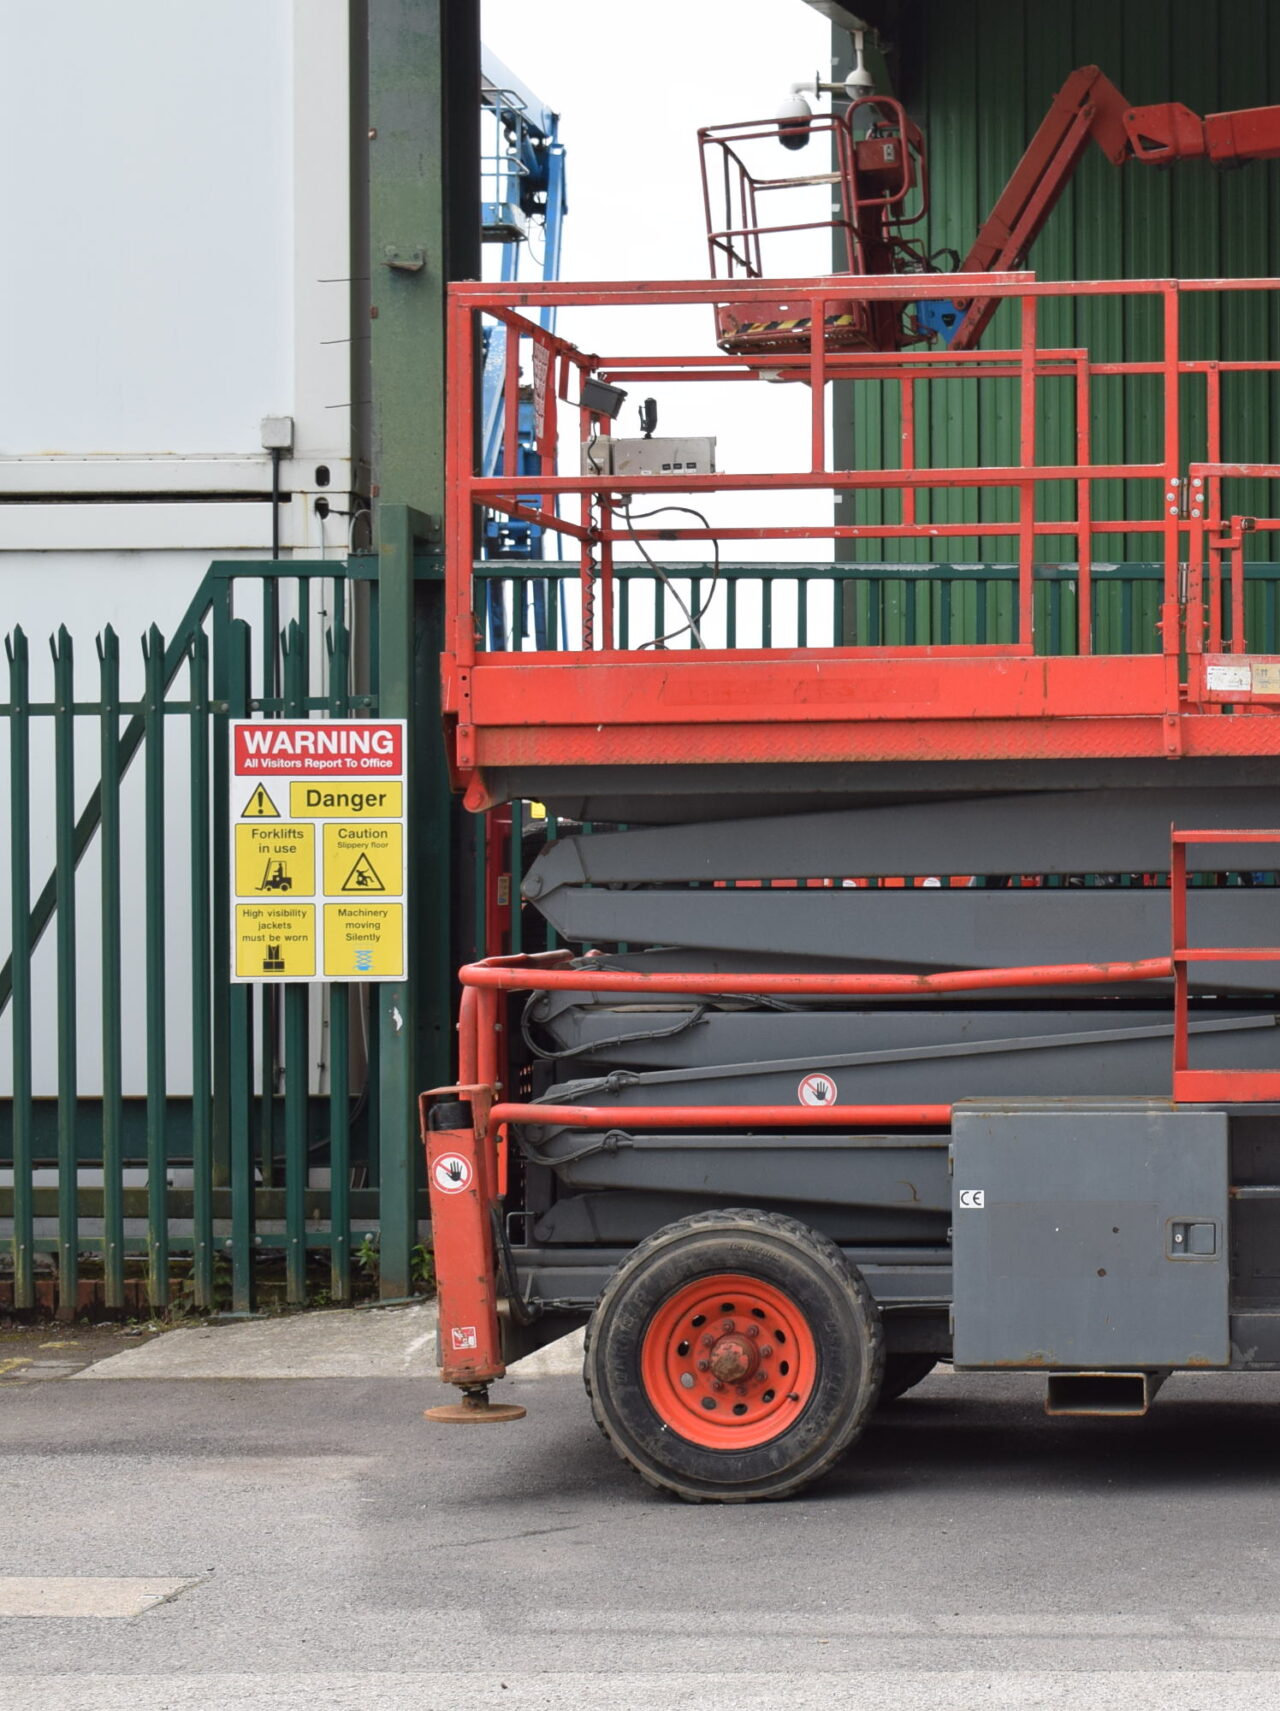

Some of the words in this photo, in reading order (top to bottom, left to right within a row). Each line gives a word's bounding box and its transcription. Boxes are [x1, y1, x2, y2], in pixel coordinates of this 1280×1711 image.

[244, 730, 394, 755] WARNING
[244, 758, 258, 768] All
[260, 758, 302, 768] Visitors
[304, 758, 342, 770] Report
[344, 758, 360, 768] To
[361, 758, 393, 768] Office
[306, 789, 386, 812] Danger
[252, 828, 304, 840] Forklifts
[338, 828, 388, 839] Caution
[258, 844, 270, 854] in
[274, 846, 297, 854] use
[337, 841, 368, 850] Slippery
[242, 909, 264, 920] High
[267, 909, 307, 919] visibility
[338, 909, 388, 918] Machinery
[258, 921, 292, 931] jackets
[346, 921, 381, 930] moving
[242, 934, 266, 942] must
[269, 933, 281, 942] be
[346, 933, 381, 942] Silently
